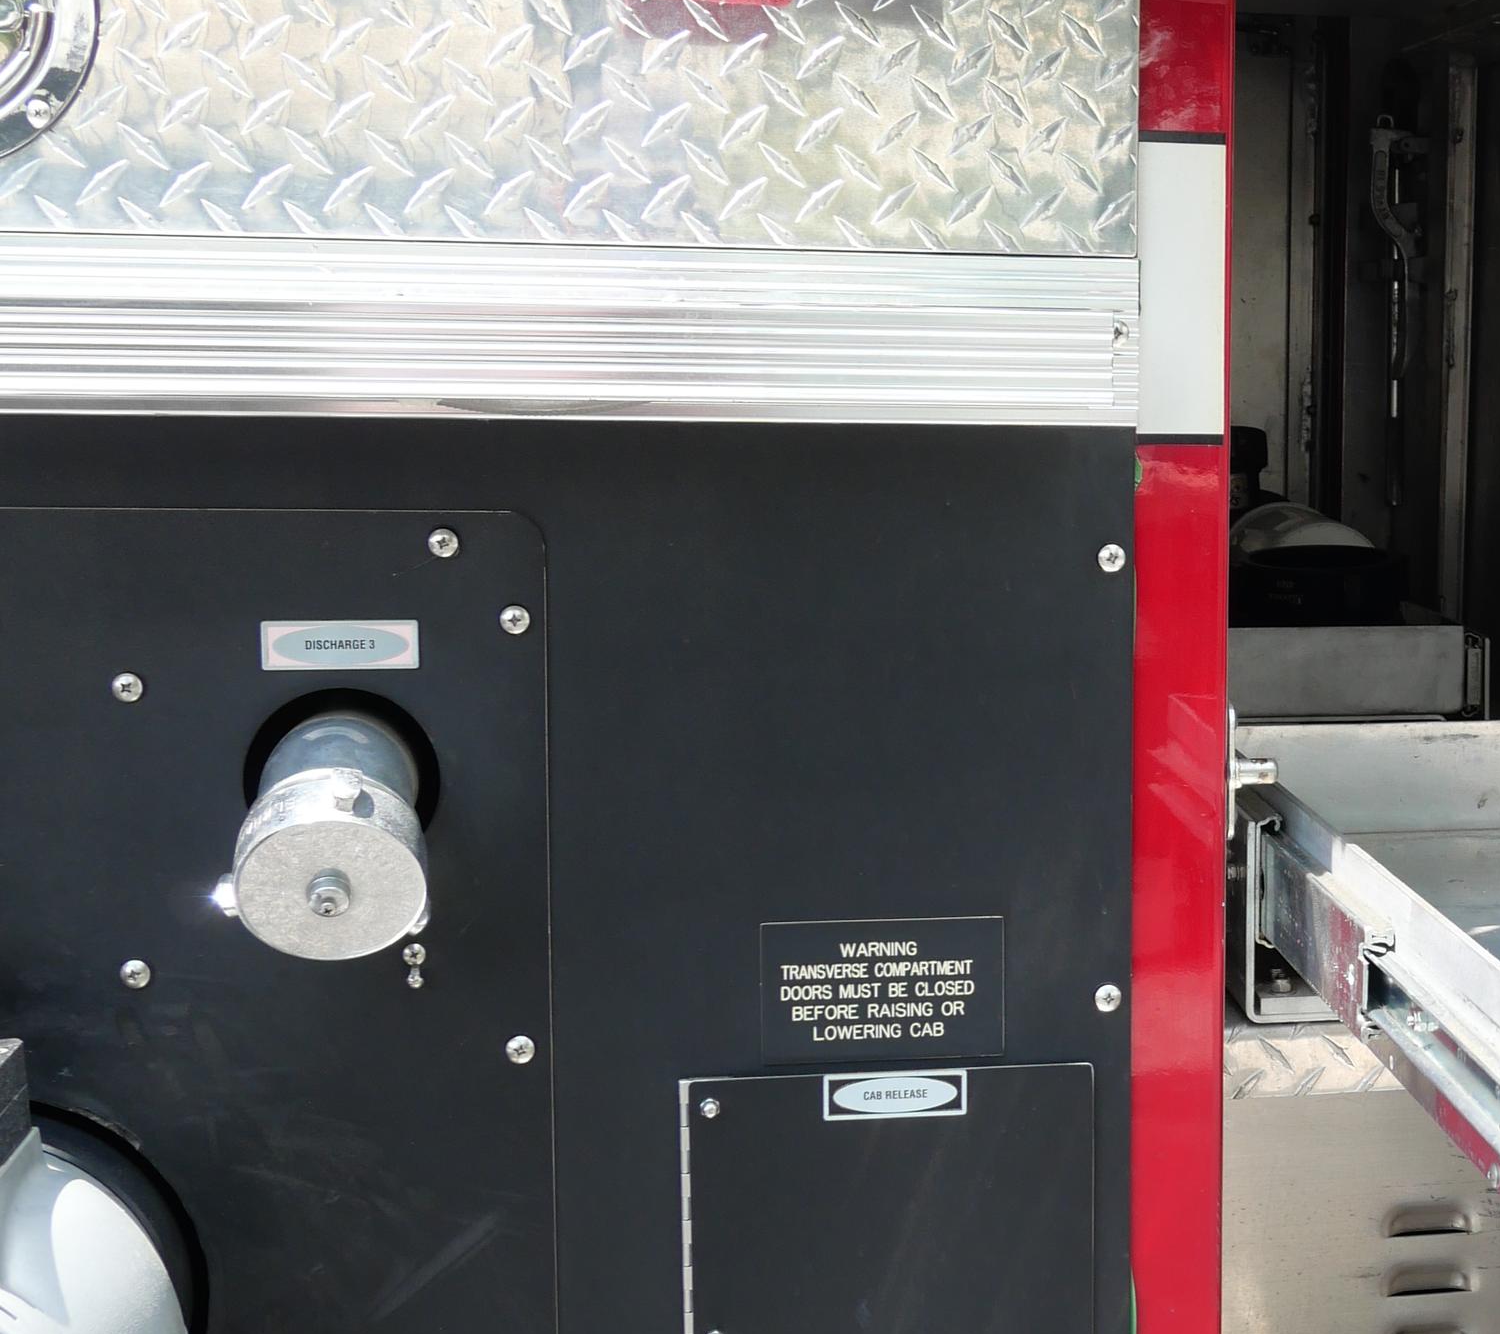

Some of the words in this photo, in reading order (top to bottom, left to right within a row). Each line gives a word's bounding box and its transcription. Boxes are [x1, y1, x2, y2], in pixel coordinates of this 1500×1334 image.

[304, 639, 366, 650] DISCHARGE
[368, 639, 376, 650] 3
[839, 940, 918, 959] WARNING
[780, 962, 869, 981] TRANSVERSE
[873, 959, 974, 978] COMPARTMENT
[780, 984, 833, 1002] DOORS
[838, 982, 882, 1000] MUST
[887, 981, 909, 998] BE
[914, 979, 976, 997] CLOSED
[791, 1003, 860, 1022] BEFORE
[866, 1001, 934, 1019] RAISING
[940, 1000, 966, 1017] OR
[812, 1022, 902, 1042] LOWERING
[909, 1021, 945, 1038] CAB
[863, 1090, 883, 1101] CAB
[885, 1088, 928, 1100] RELEASE
